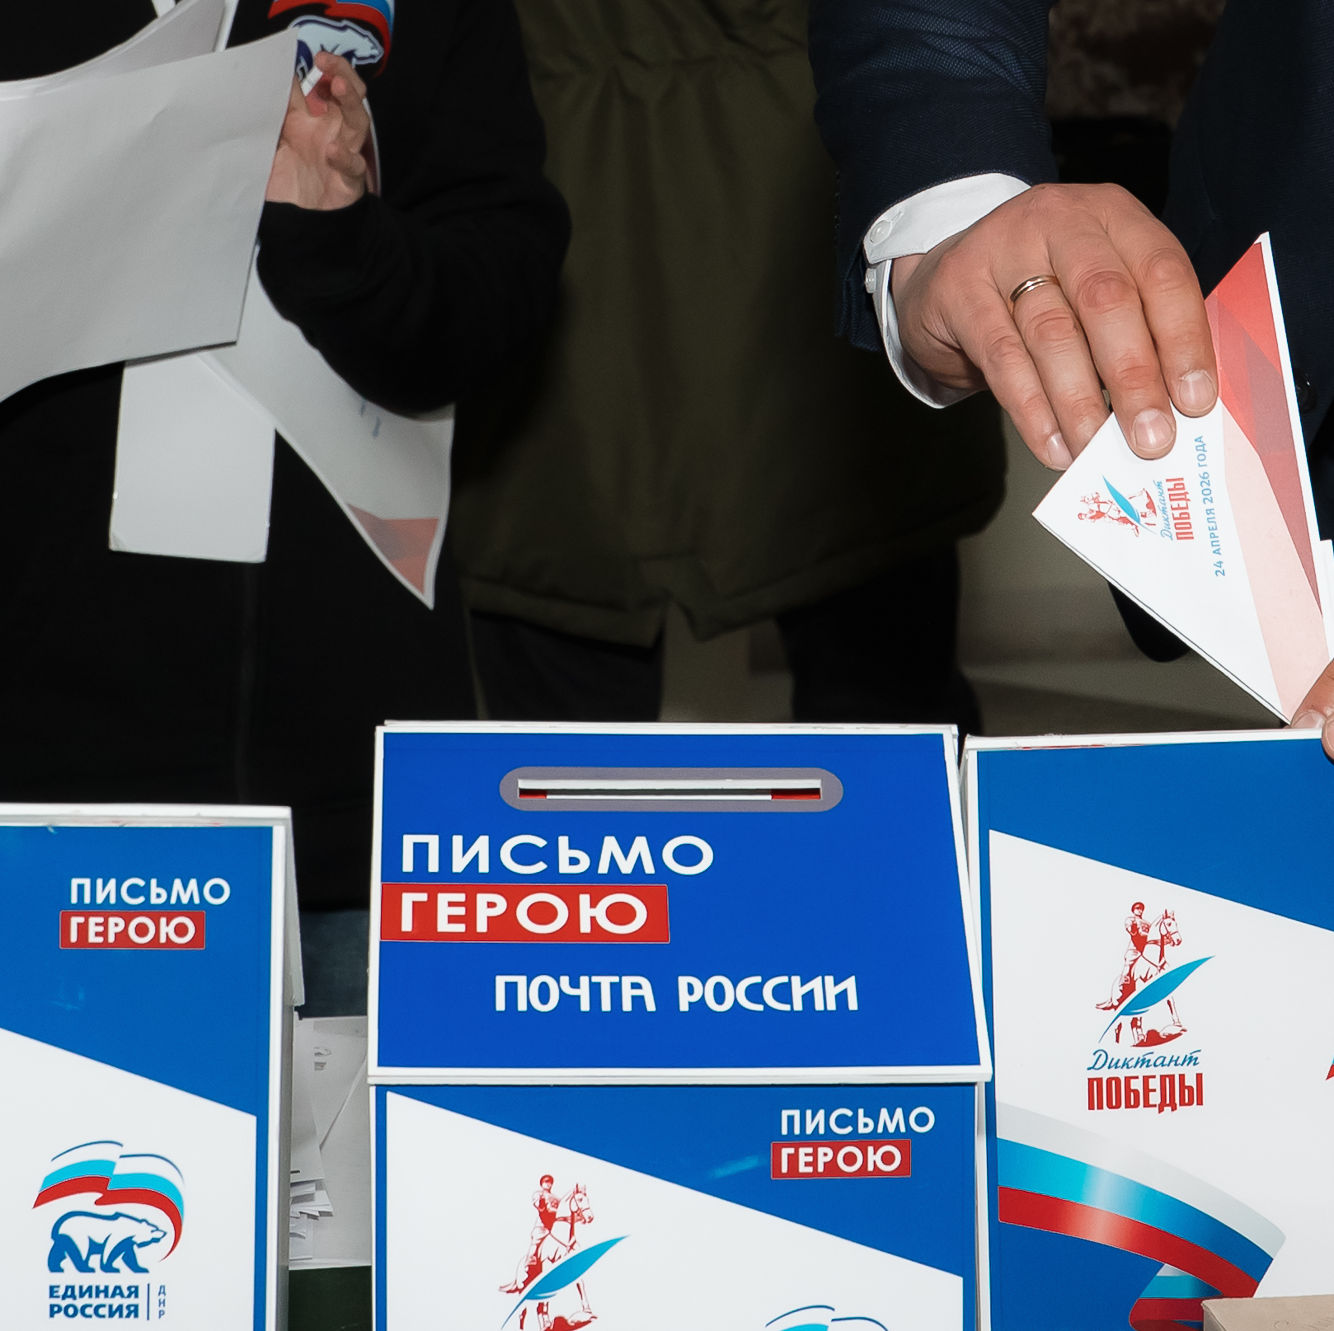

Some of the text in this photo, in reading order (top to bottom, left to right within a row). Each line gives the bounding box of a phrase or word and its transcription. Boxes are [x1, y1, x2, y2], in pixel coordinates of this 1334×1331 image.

[1153, 479, 1174, 541] Диктант
[1165, 477, 1195, 541] ПОБЕДЫ
[1194, 435, 1226, 577] 24 АПРЕЛЯ 2026 ГОДА
[402, 834, 715, 876] ПИСЬМО
[70, 876, 232, 906] ПИСЬМО
[69, 915, 197, 945] ГЕРОЮ
[401, 892, 649, 935] ГЕРОЮ
[494, 974, 859, 1013] ПОЧТА РОССИИ
[1085, 1047, 1202, 1072] Диктант
[1086, 1072, 1204, 1115] ПОБЕДЫ
[779, 1105, 936, 1136] ПИСЬМО
[780, 1144, 903, 1175] ГЕРОЮ
[48, 1283, 141, 1302] ЕДИНАЯ
[48, 1302, 141, 1320] РОССИЯ
[157, 1283, 167, 1320] ДНР
